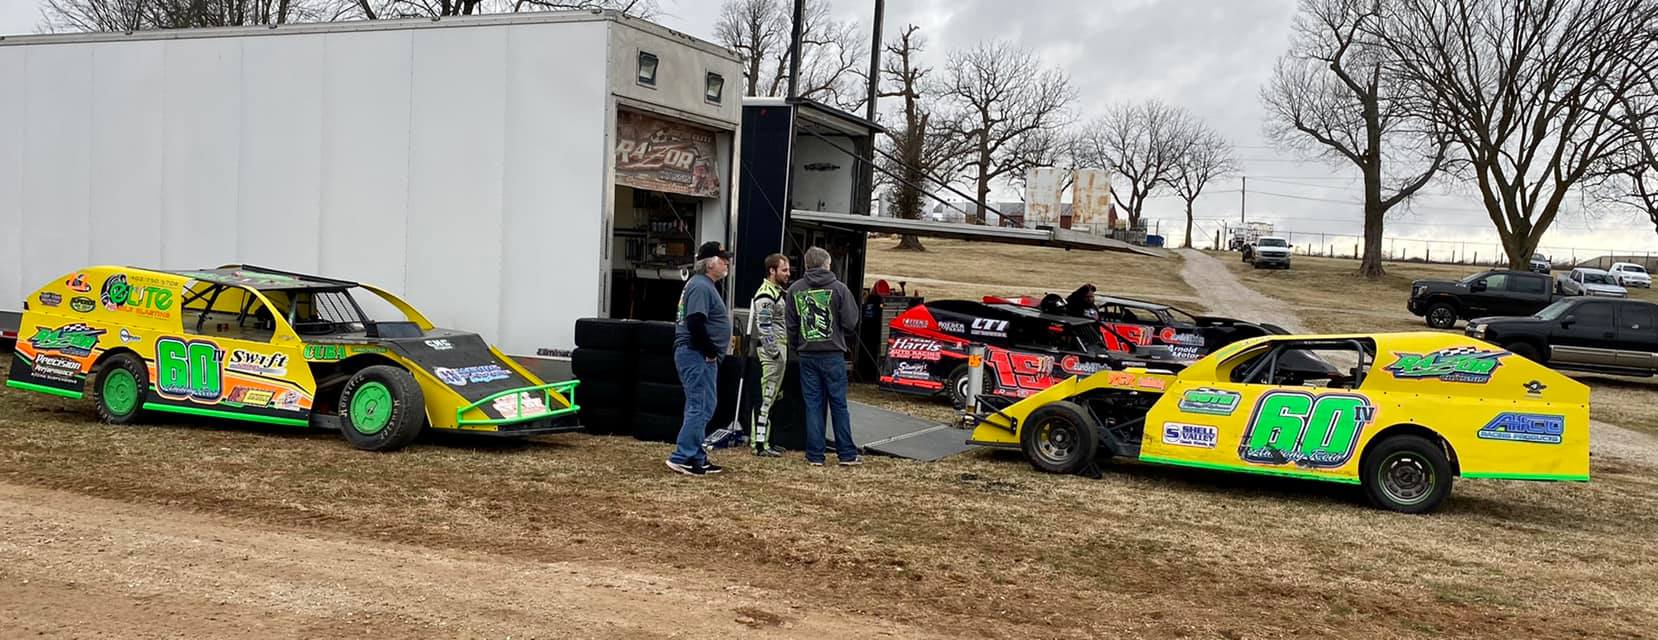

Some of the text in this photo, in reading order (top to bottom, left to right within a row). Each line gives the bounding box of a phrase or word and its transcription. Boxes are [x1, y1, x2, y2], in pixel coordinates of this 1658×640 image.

[617, 139, 694, 170] RAZOR
[971, 317, 1009, 331] LTI
[304, 344, 346, 360] CUBA
[891, 338, 942, 352] Harris
[1168, 345, 1198, 353] Arnold
[35, 354, 82, 370] Precision
[230, 349, 287, 368] Swift
[1393, 355, 1498, 375] RAZOR
[159, 340, 222, 396] 60
[213, 350, 226, 361] IV
[1183, 426, 1213, 434] SHELL
[1250, 393, 1363, 456] 60
[1354, 406, 1375, 421] IV
[1183, 433, 1216, 442] VALLEY
[1513, 433, 1559, 442] PRODUCTS
